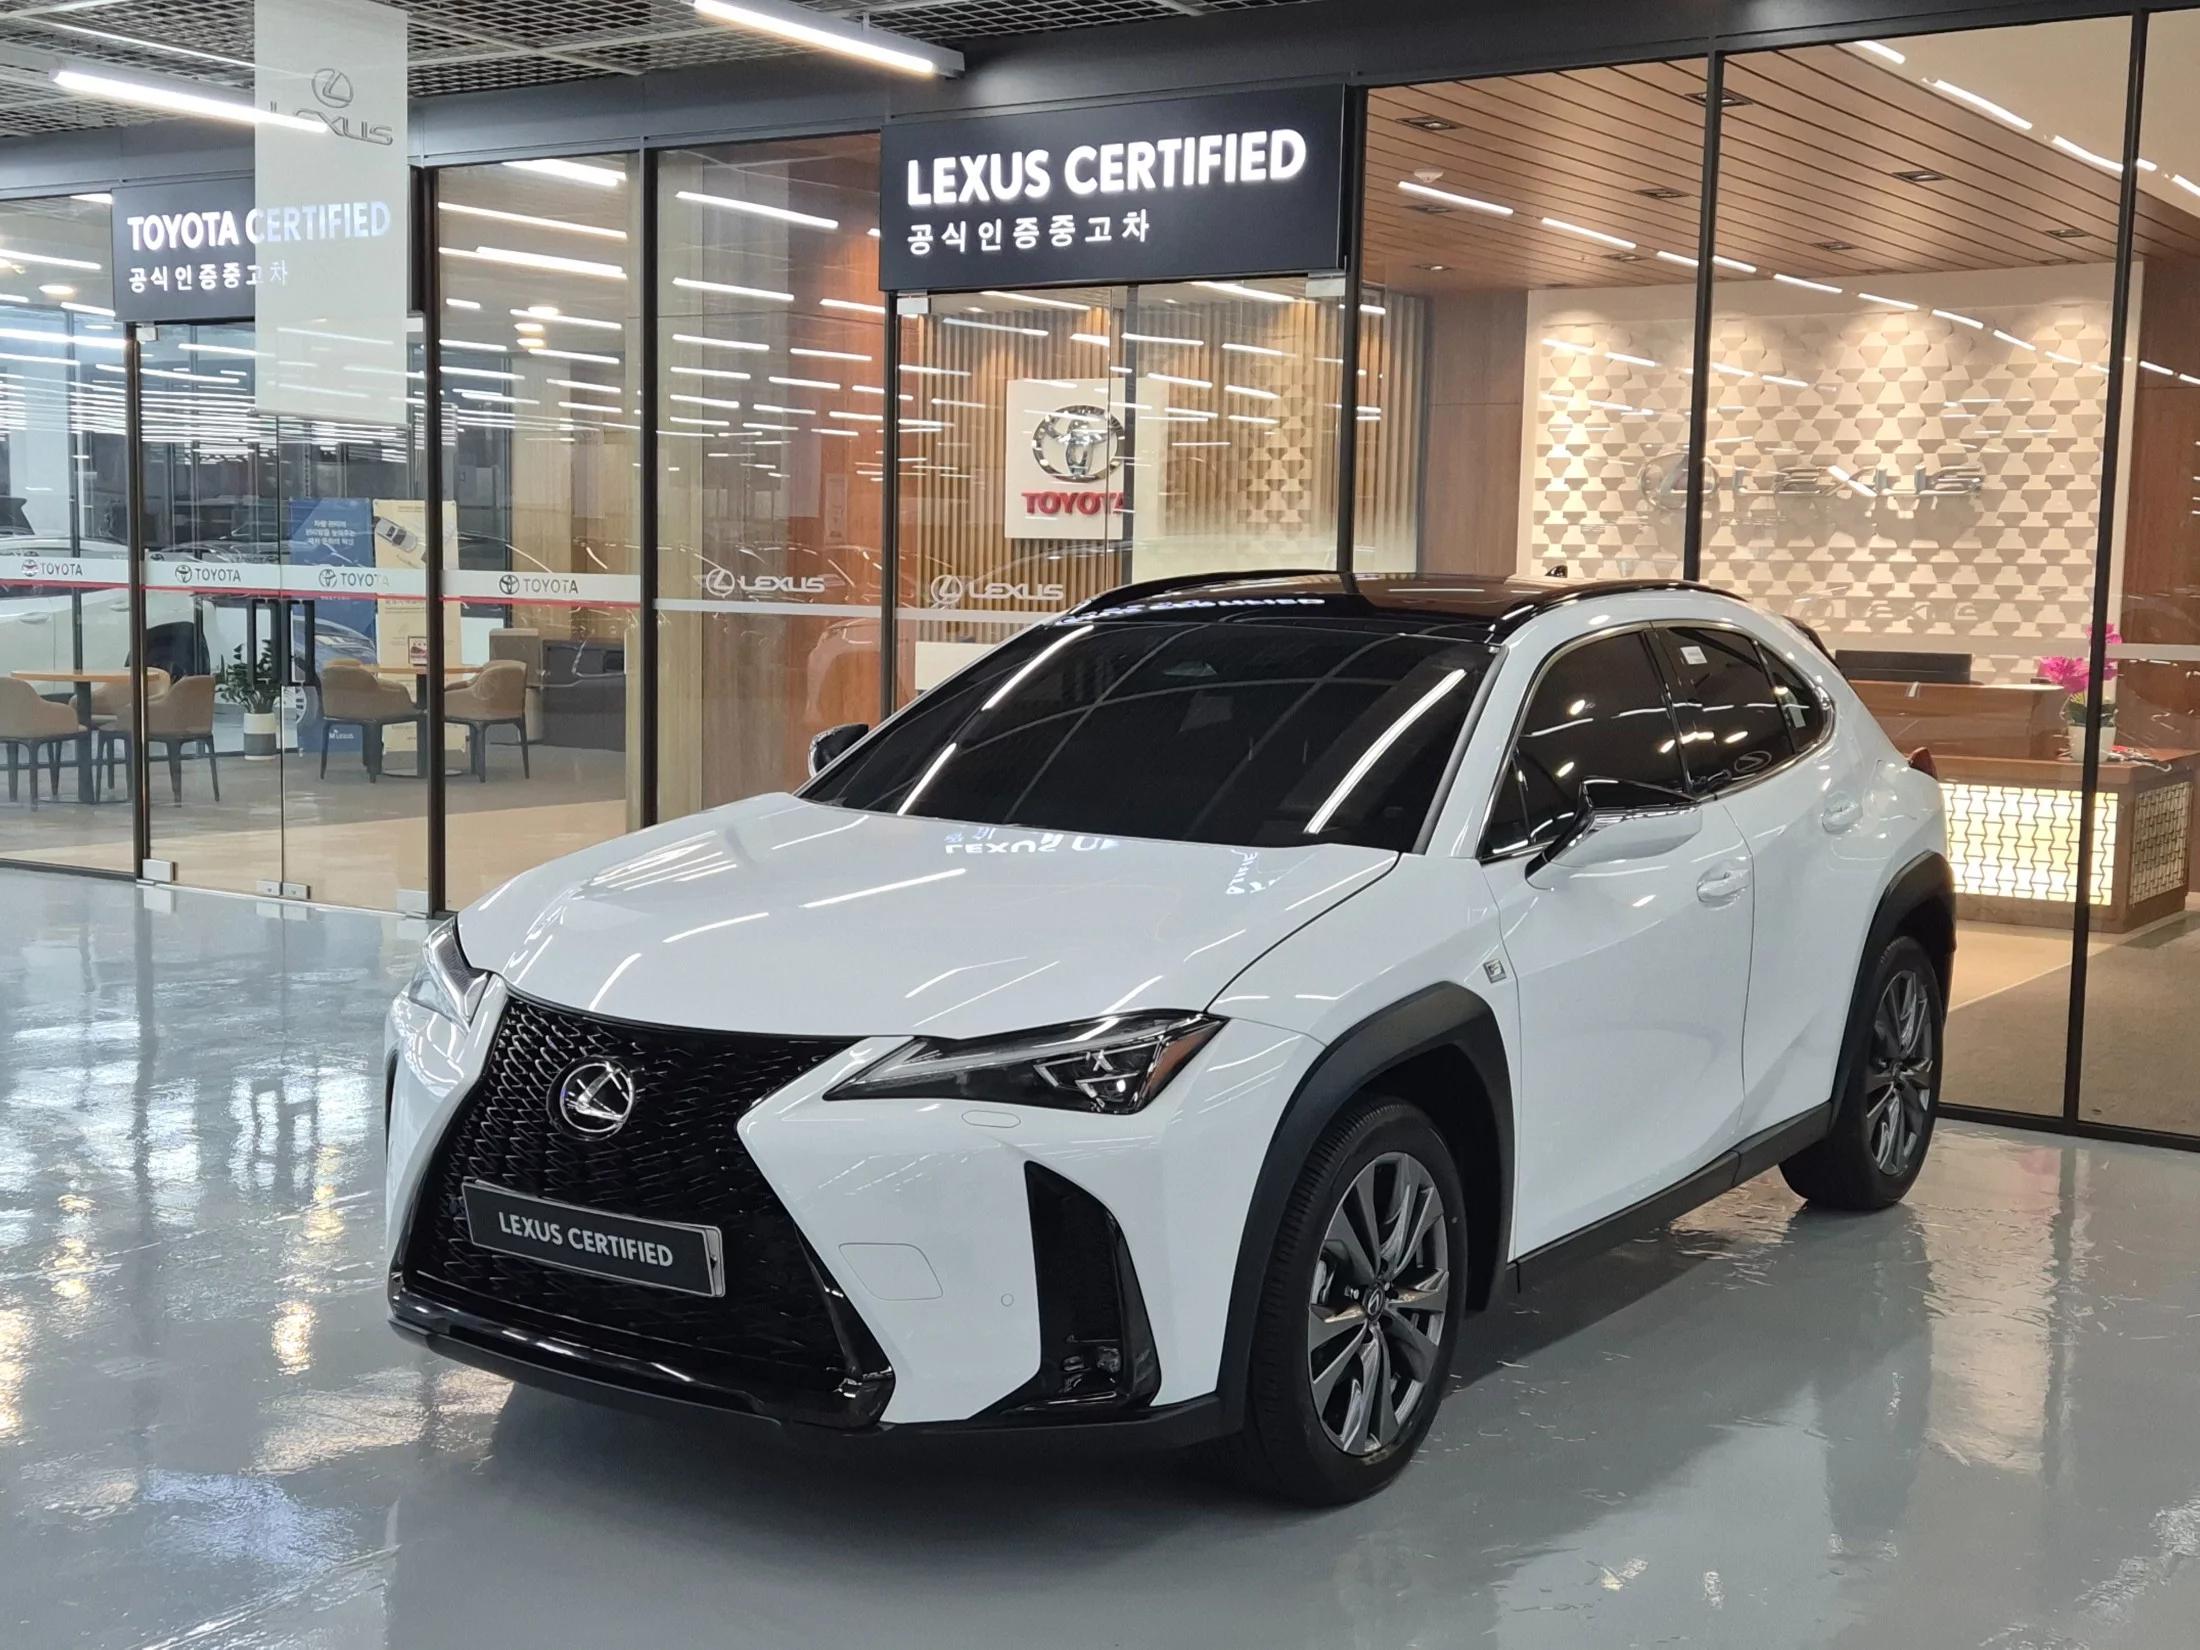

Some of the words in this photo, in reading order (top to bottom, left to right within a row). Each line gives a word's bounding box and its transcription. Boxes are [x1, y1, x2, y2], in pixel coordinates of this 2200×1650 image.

[907, 149, 1051, 206] LEXUS
[1064, 128, 1307, 195] CERTIFIED
[127, 210, 240, 250] TOYOTA
[245, 200, 391, 245] CERTIFIED
[1732, 463, 1985, 498] LEXUS
[41, 562, 83, 577] TOYOTA
[195, 567, 241, 583] TOYOTA
[522, 577, 579, 594] TOYOTA
[740, 575, 825, 593] LEXUS
[969, 583, 1064, 600] LEXUS
[499, 1211, 563, 1246] LEXUS
[567, 1227, 673, 1267] CERTIFIED
